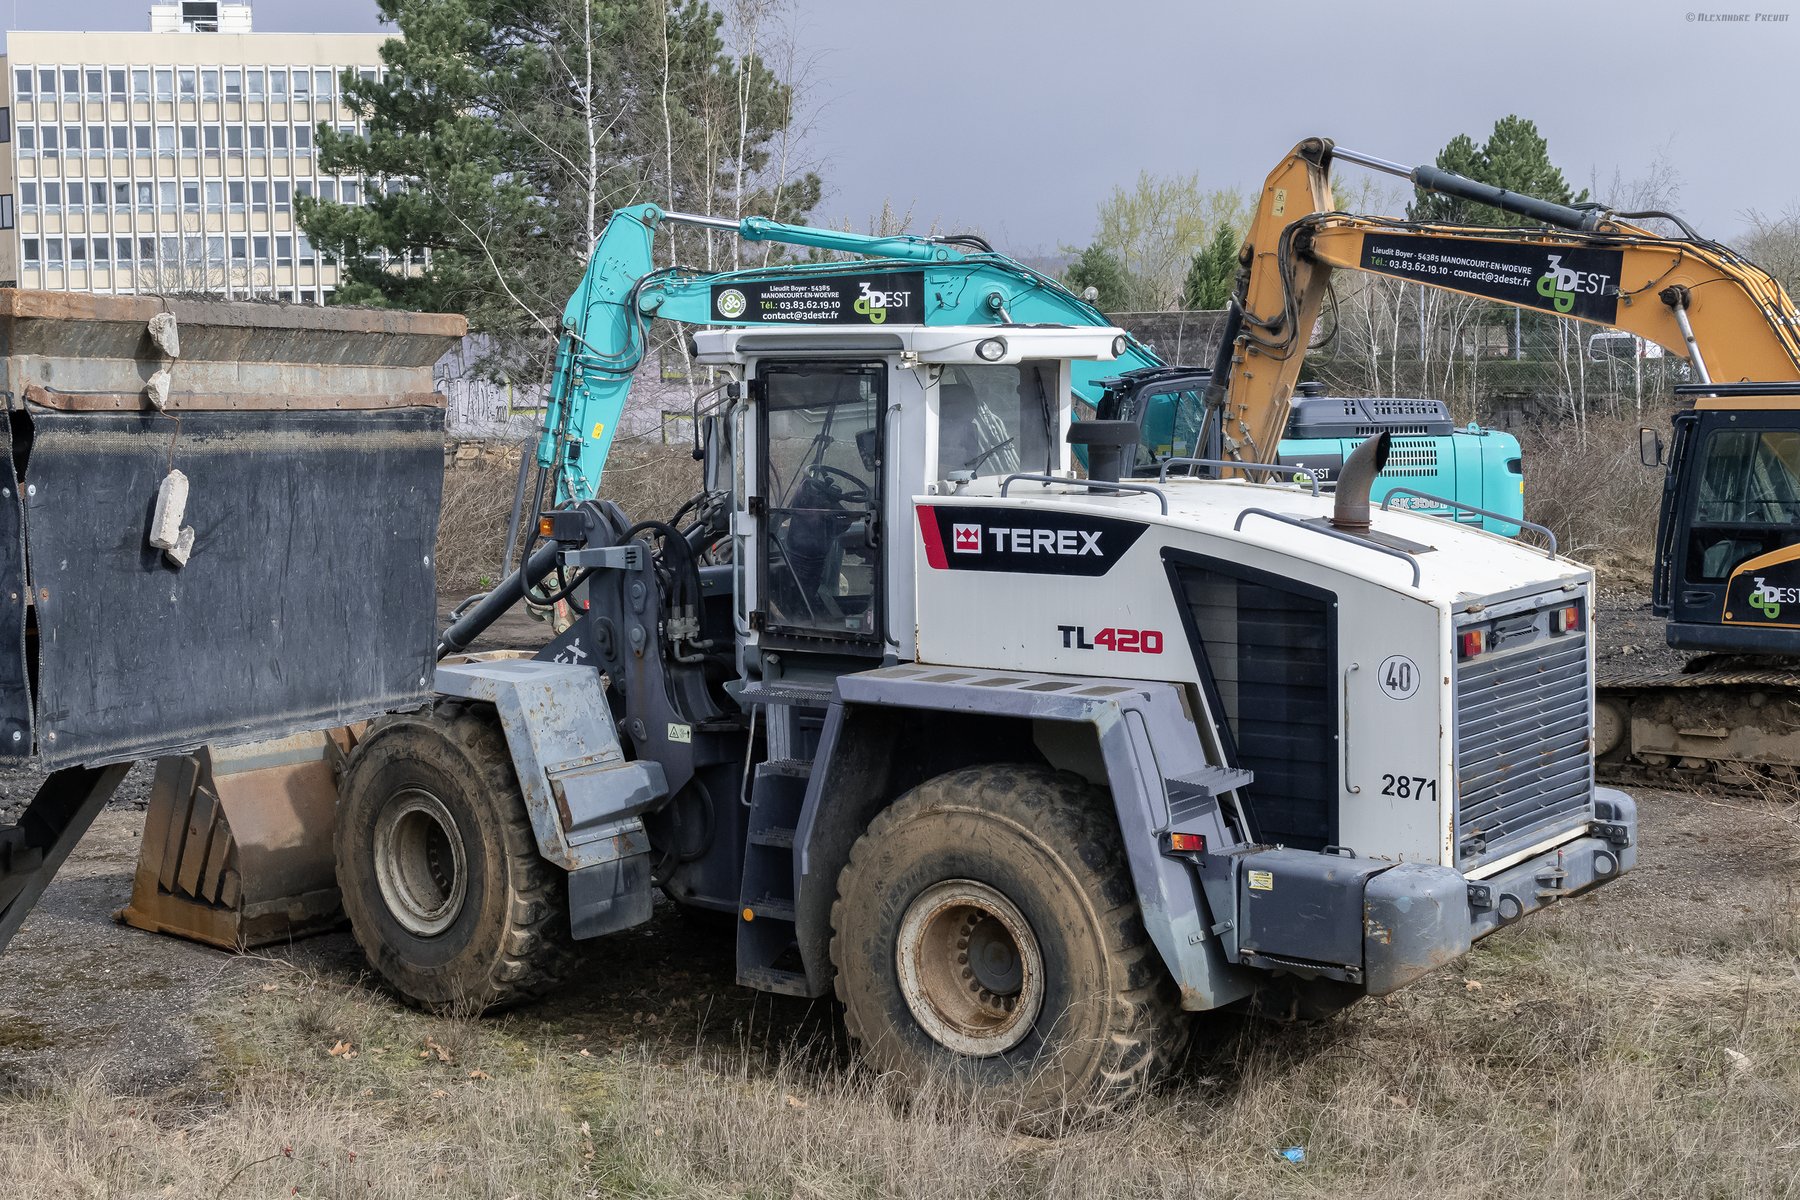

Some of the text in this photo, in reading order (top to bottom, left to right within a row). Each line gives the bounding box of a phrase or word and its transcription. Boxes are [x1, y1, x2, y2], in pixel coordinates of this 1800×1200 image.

[1372, 246, 1394, 256] Lieudit
[1395, 249, 1414, 259] Boyer
[1418, 253, 1439, 263] 54385
[1440, 255, 1533, 275] MANONCOURT-EN-WOEVRE
[1389, 259, 1448, 275] 03.83.62.19.10
[1453, 268, 1531, 287] contact@3destr.fr
[761, 291, 839, 299] MANONCOURT-EN-WOEVRE
[790, 285, 807, 293] Boyer
[762, 311, 839, 321] contact@3destr.fr
[779, 301, 841, 310] 03.83.62.19.10
[988, 527, 1104, 556] TEREX
[1057, 624, 1164, 655] TL420
[1385, 661, 1411, 692] 40
[1381, 773, 1437, 802] 2871
